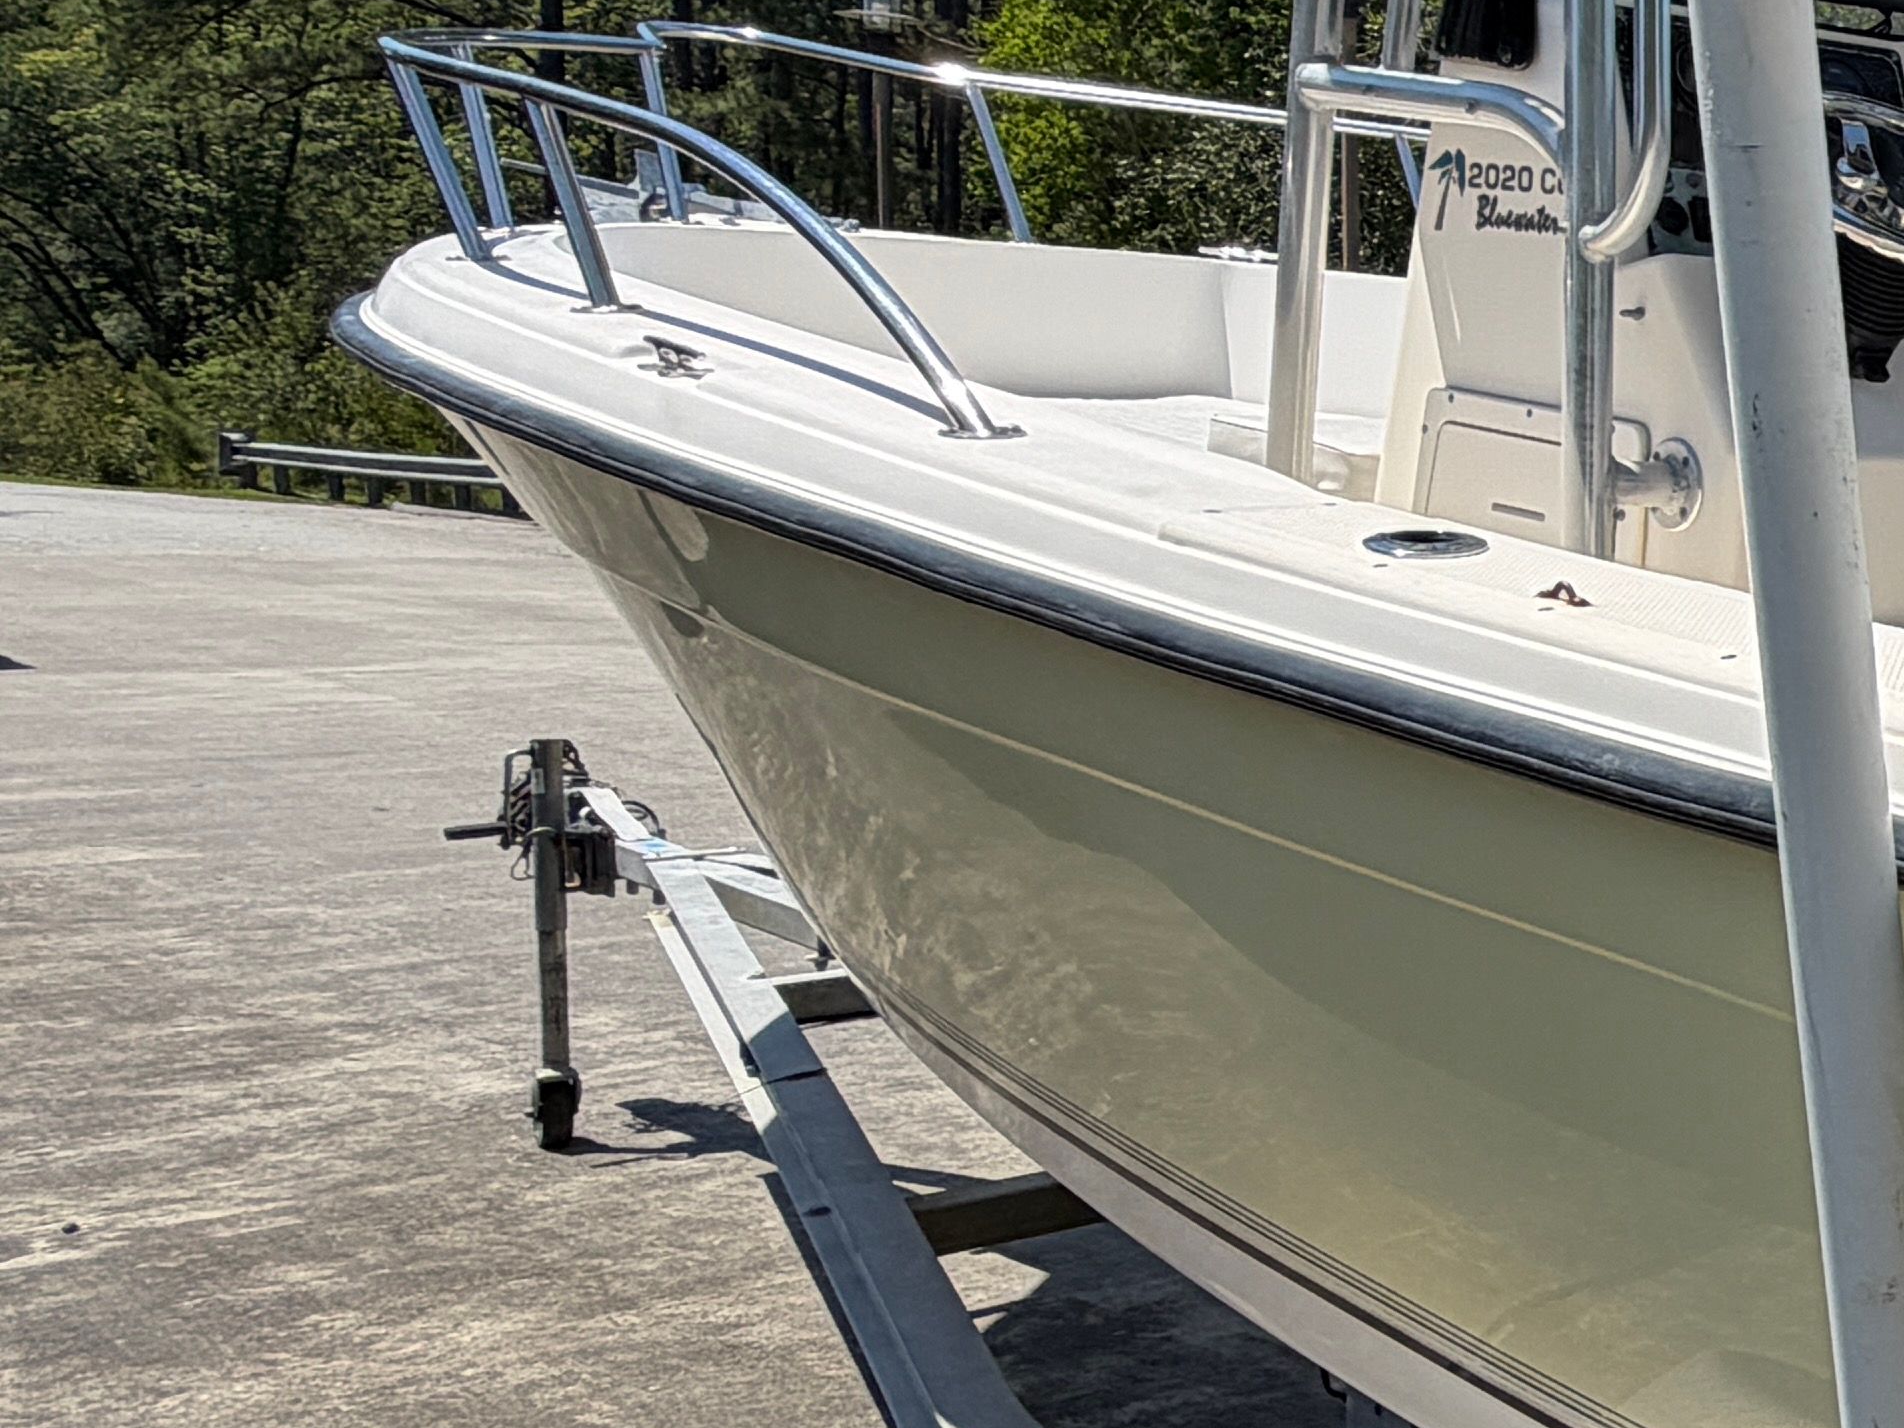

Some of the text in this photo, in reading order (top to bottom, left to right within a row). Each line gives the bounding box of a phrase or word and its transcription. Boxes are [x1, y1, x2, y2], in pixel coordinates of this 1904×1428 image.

[1468, 162, 1564, 195] 2020 C
[1475, 194, 1568, 235] Bluewater
